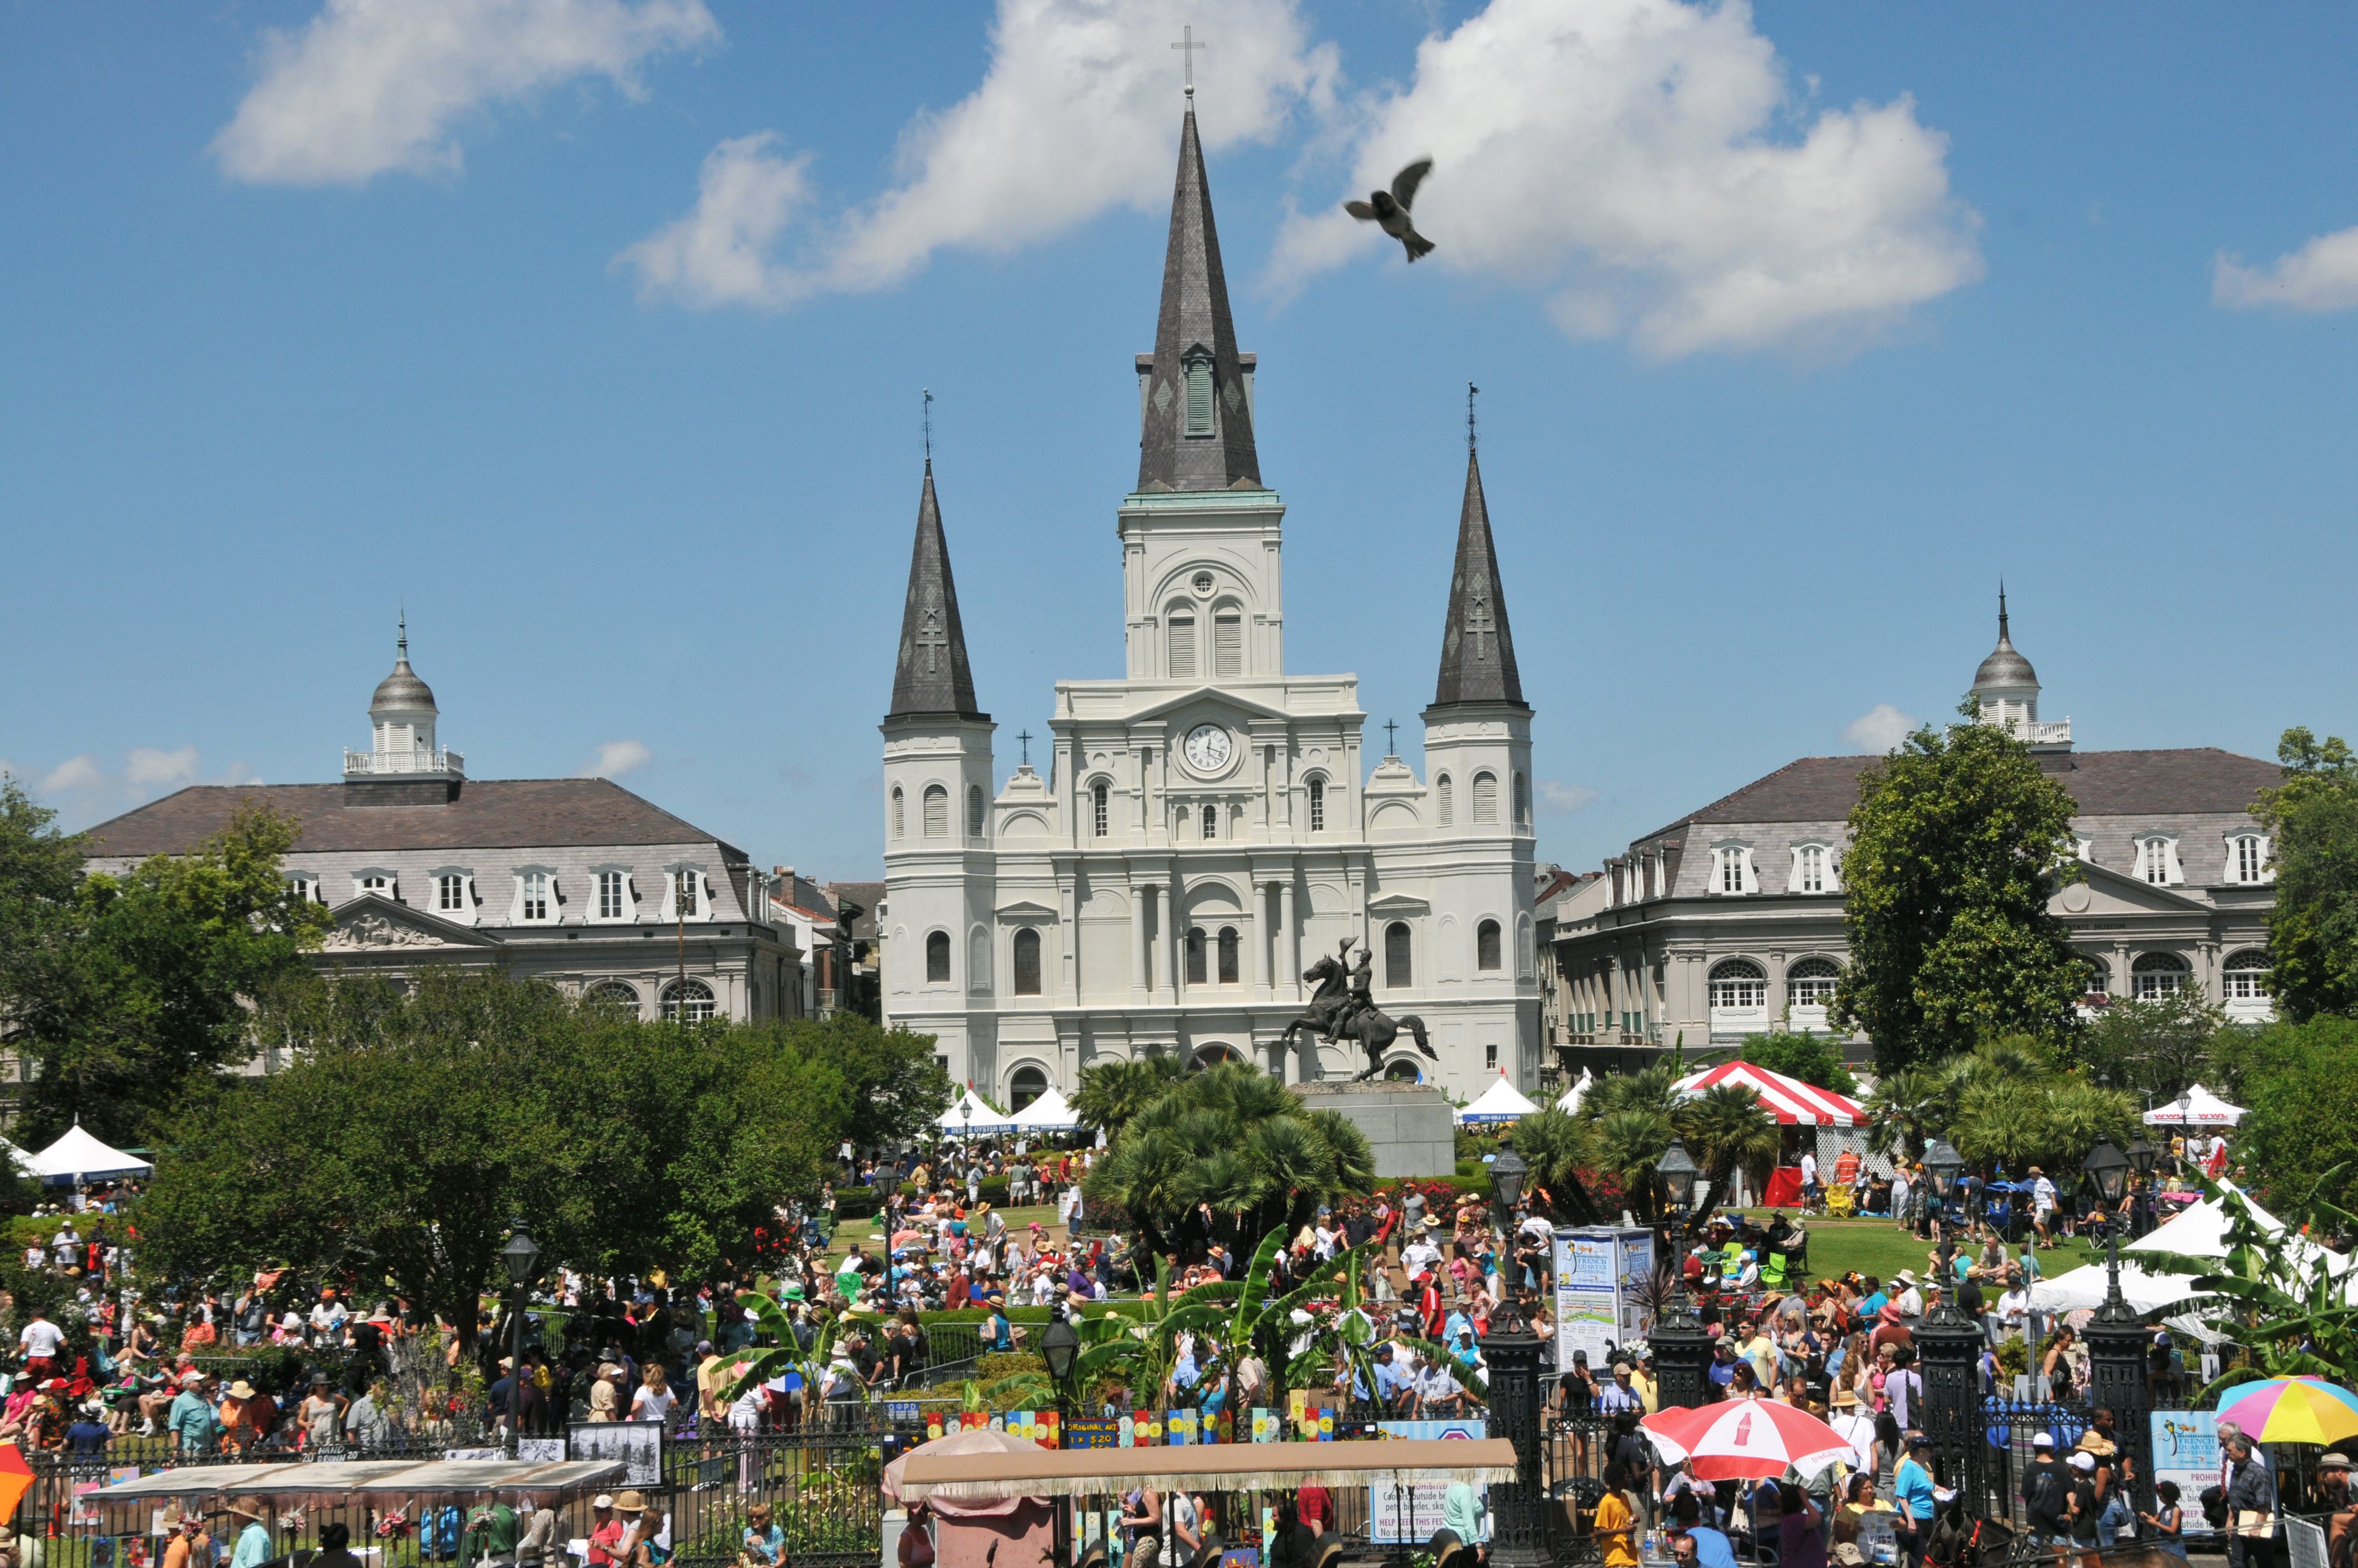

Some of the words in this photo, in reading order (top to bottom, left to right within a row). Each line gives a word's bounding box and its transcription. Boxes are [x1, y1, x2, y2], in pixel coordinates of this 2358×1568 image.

[1090, 1434, 1111, 1444] $20
[318, 1446, 345, 1454] HAND
[317, 1454, 346, 1463] DRAWN
[1384, 1491, 1410, 1501] Cooers,
[1404, 1502, 1430, 1512] biycles,
[2182, 1519, 2203, 1528] utside
[1381, 1528, 1390, 1537] No
[1420, 1528, 1435, 1536] food
